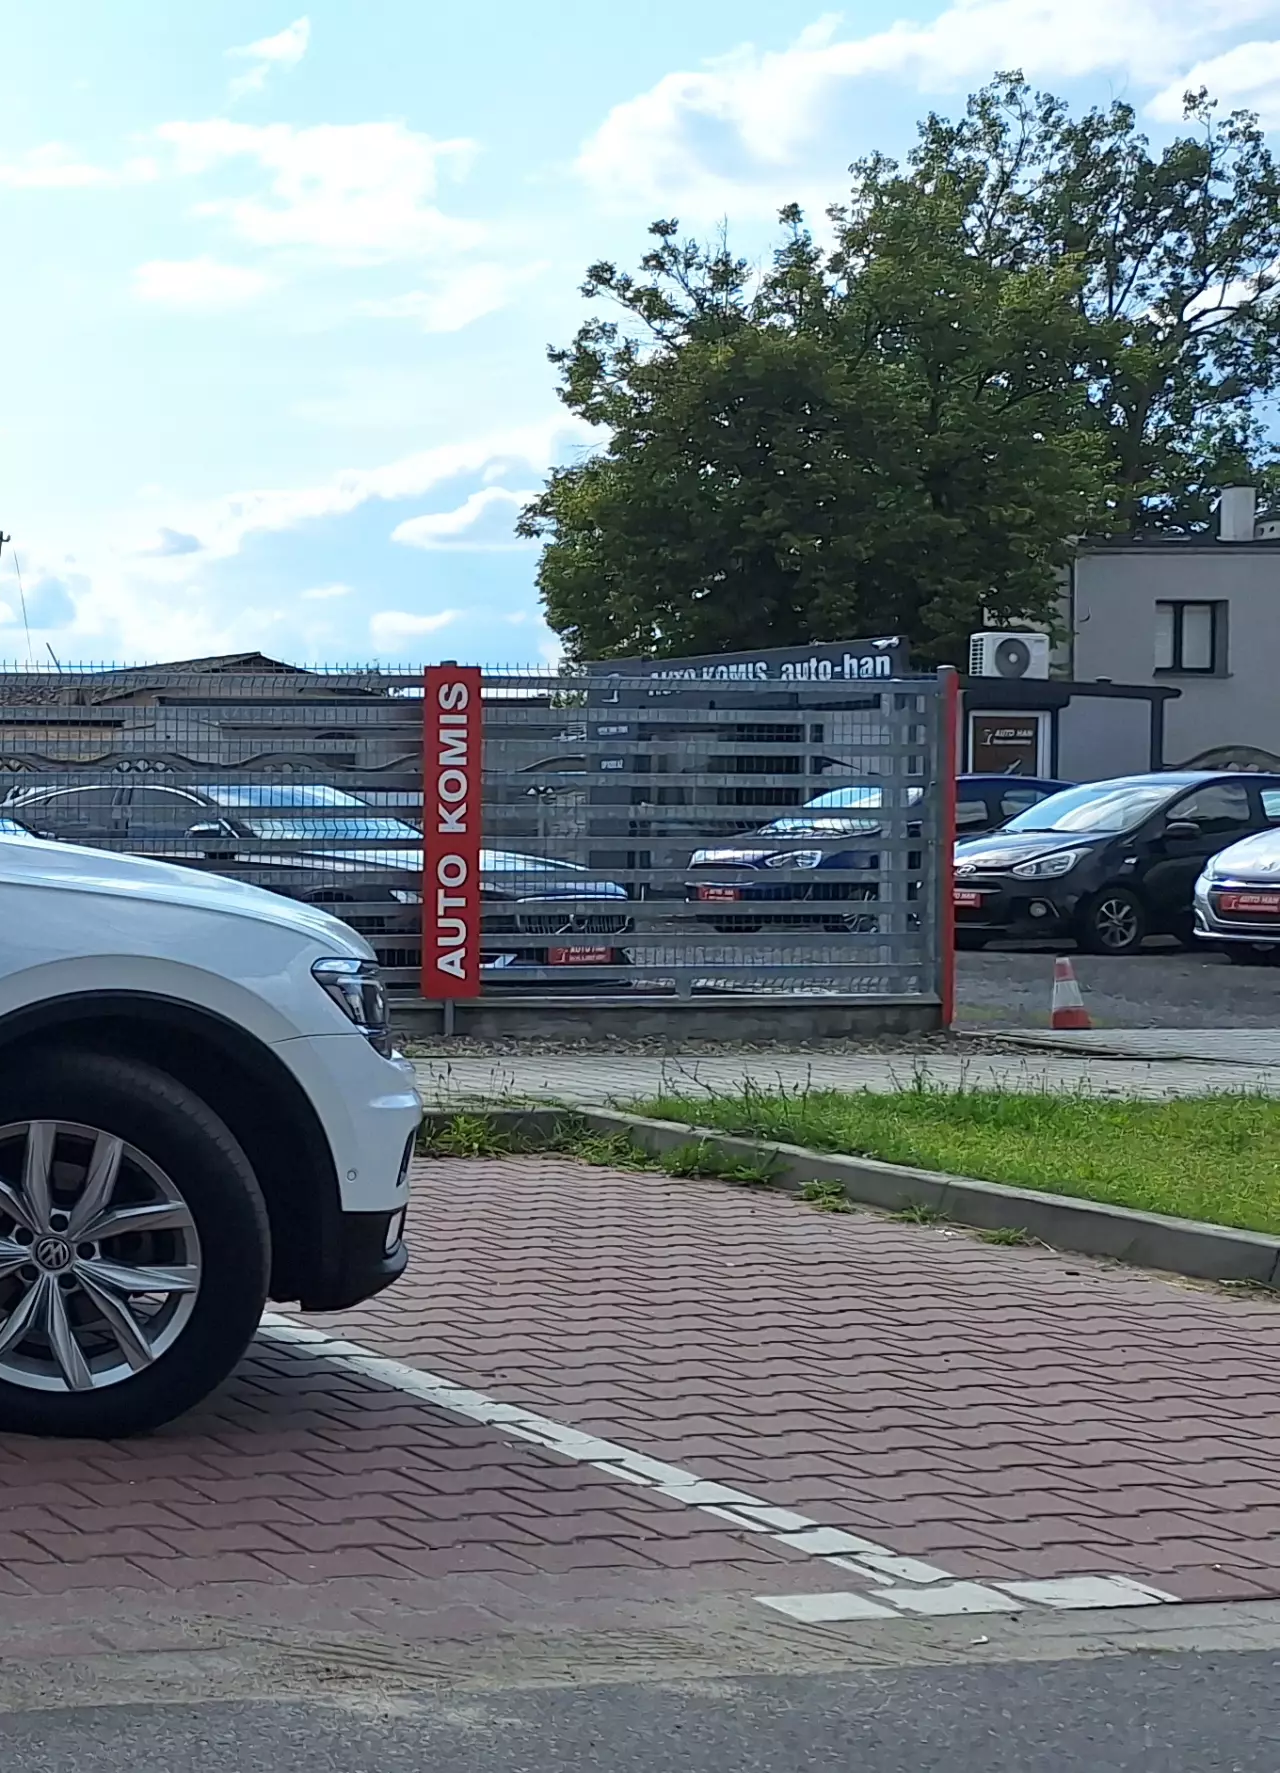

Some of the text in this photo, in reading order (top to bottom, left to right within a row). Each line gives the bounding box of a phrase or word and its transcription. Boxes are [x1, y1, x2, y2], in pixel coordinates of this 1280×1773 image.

[780, 653, 891, 682] auto-han
[436, 681, 469, 980] AUTO KOMIS
